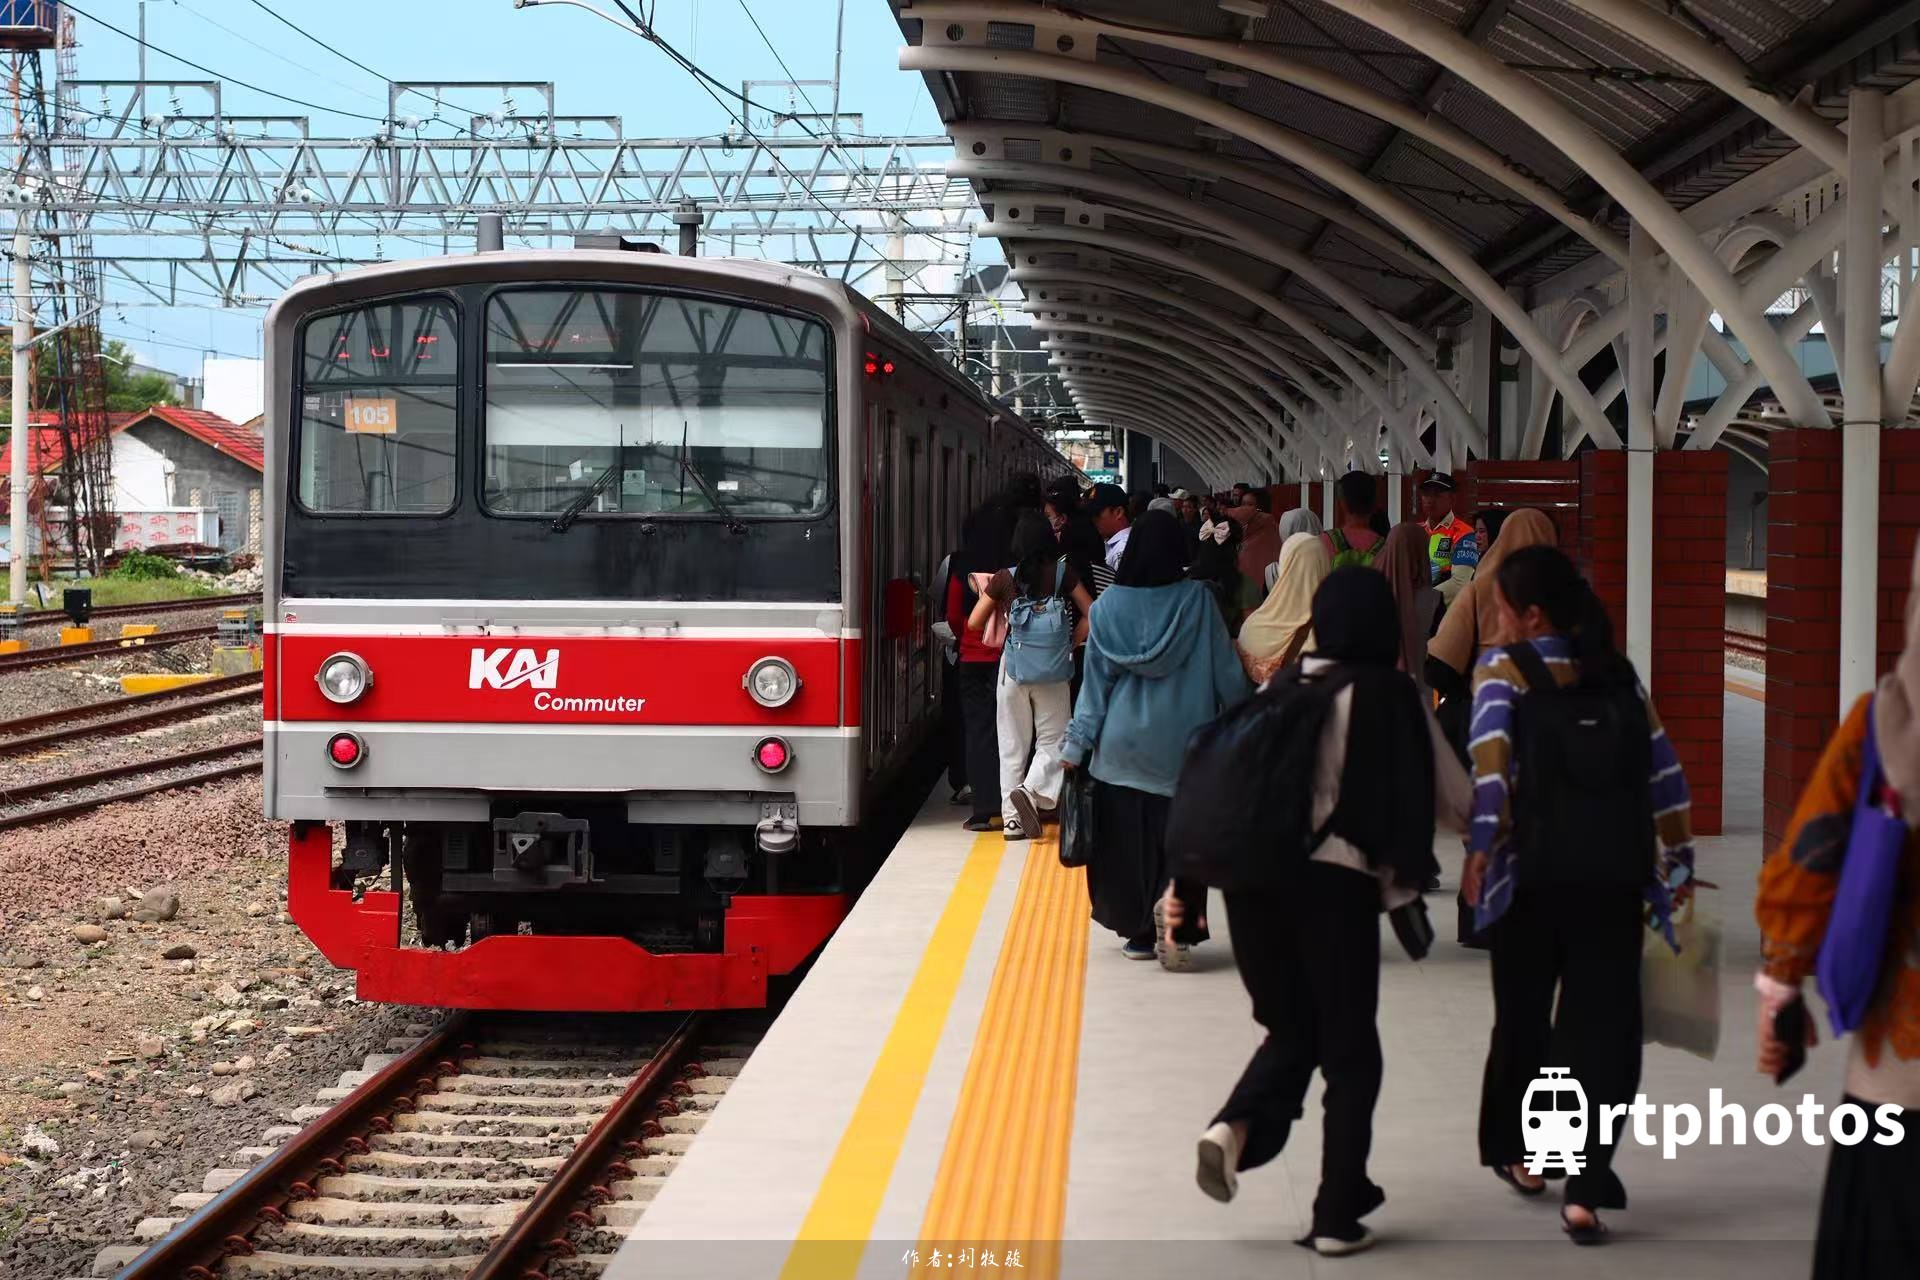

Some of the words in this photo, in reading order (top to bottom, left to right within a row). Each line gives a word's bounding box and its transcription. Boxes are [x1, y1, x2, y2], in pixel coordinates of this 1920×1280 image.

[351, 406, 390, 425] 105
[469, 648, 560, 690] KAI
[533, 692, 646, 712] Commuter
